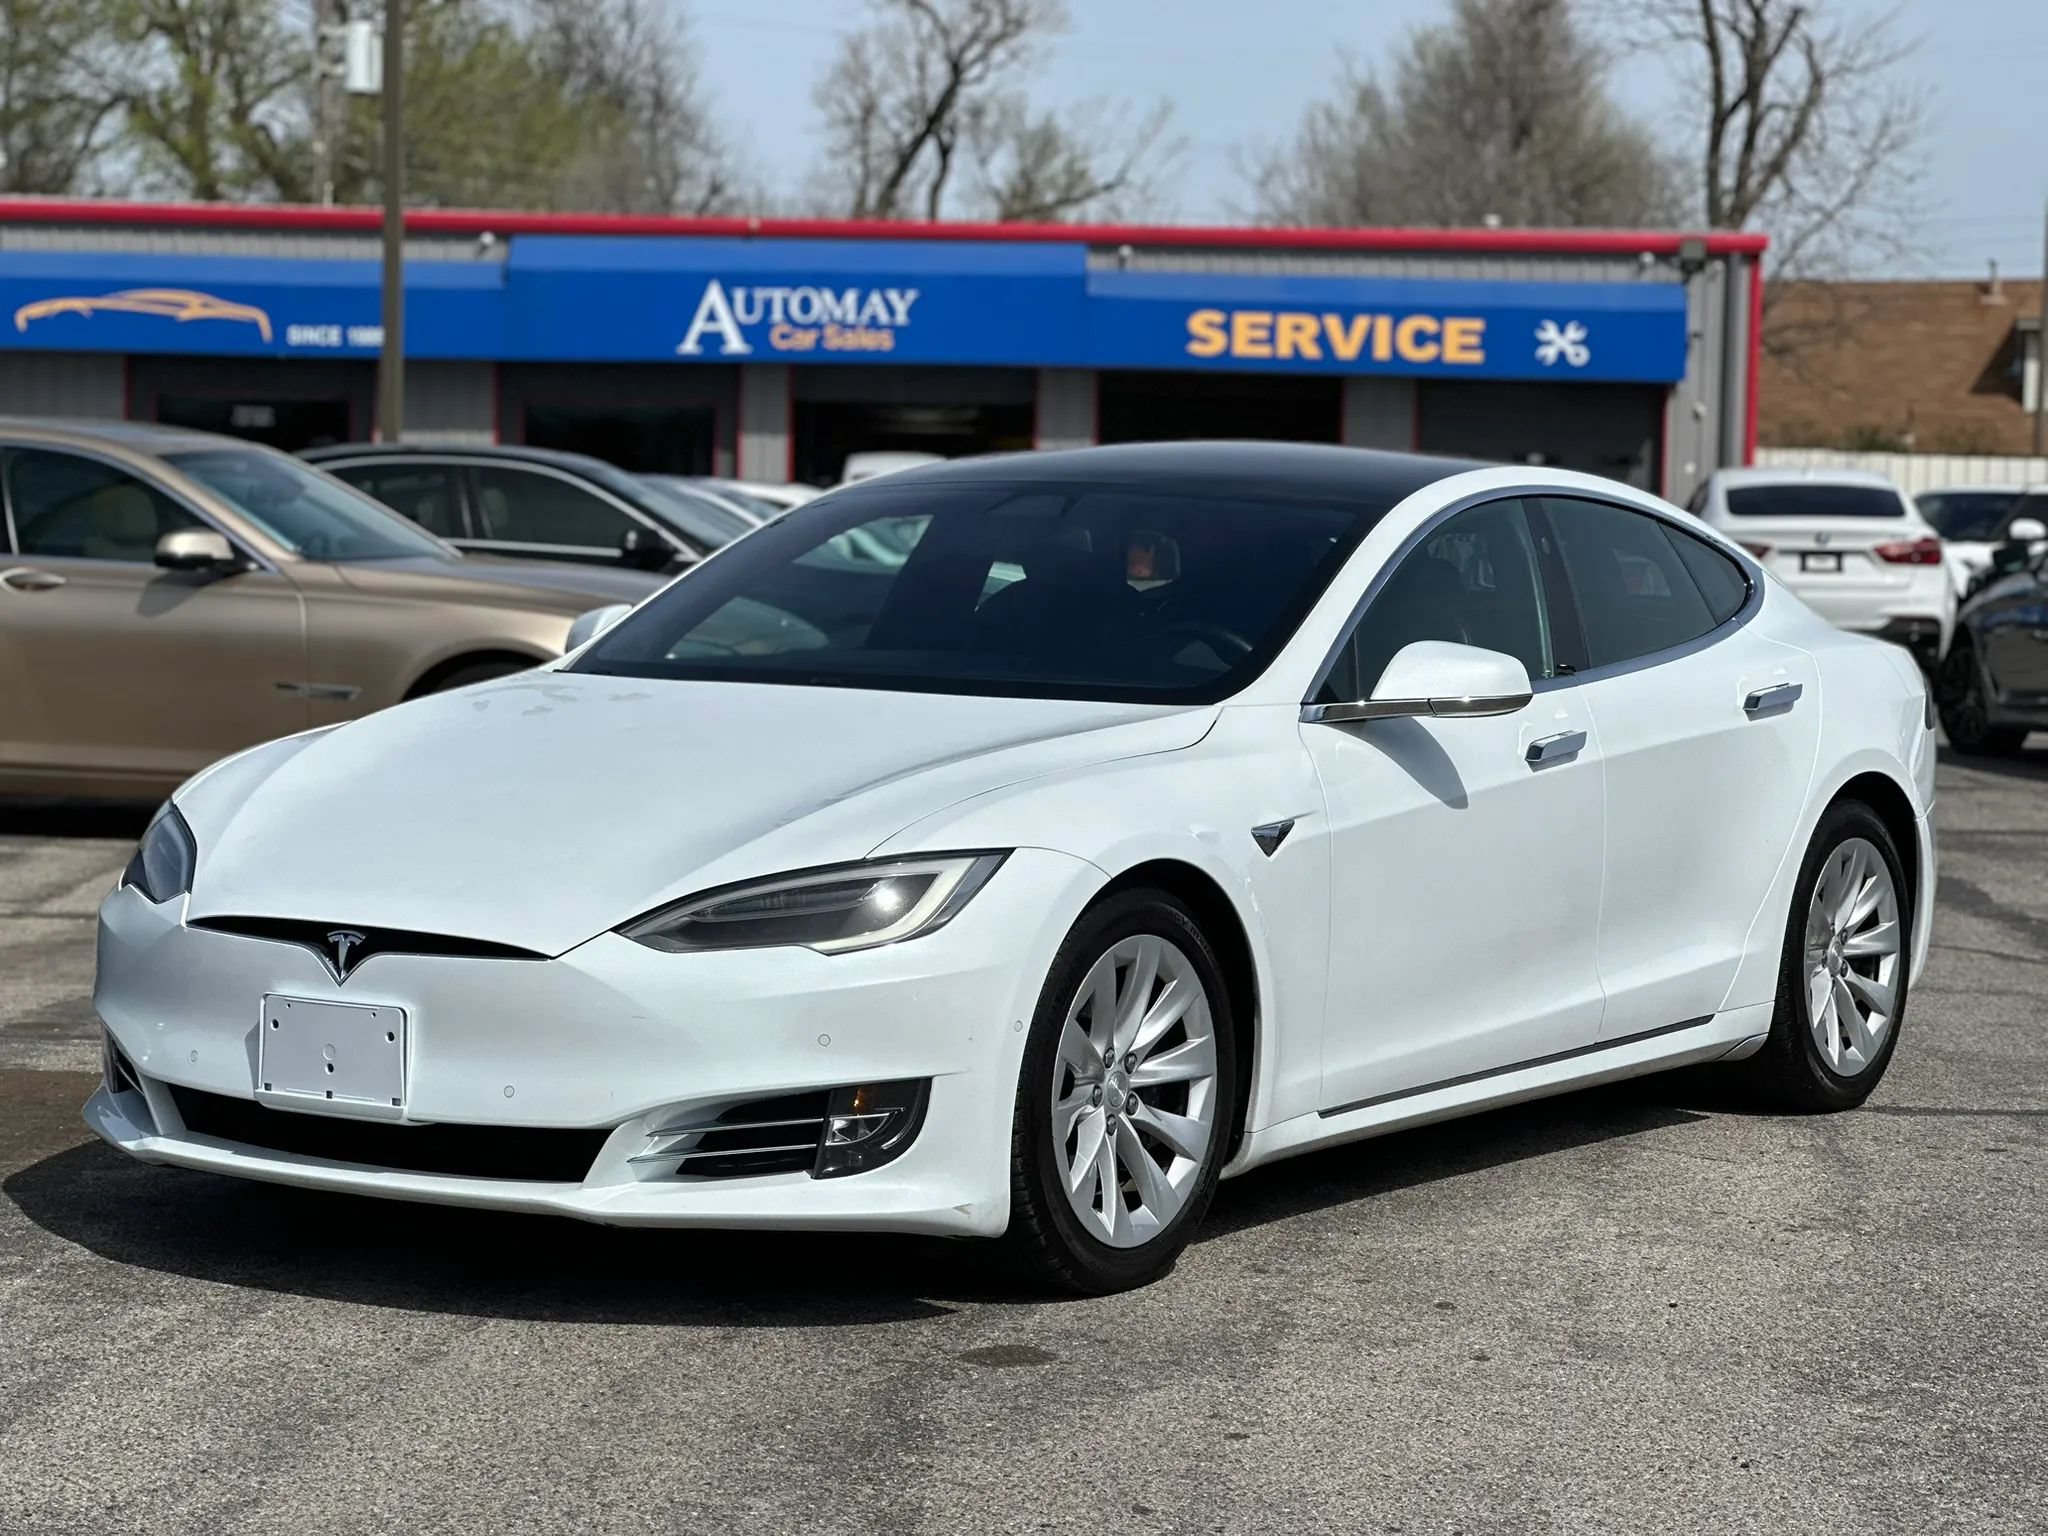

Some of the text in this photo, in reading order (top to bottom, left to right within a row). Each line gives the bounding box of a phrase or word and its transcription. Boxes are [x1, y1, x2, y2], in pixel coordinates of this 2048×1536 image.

[286, 324, 342, 347] SINCE
[769, 324, 894, 352] Car Sales
[1186, 309, 1486, 364] SERVICE
